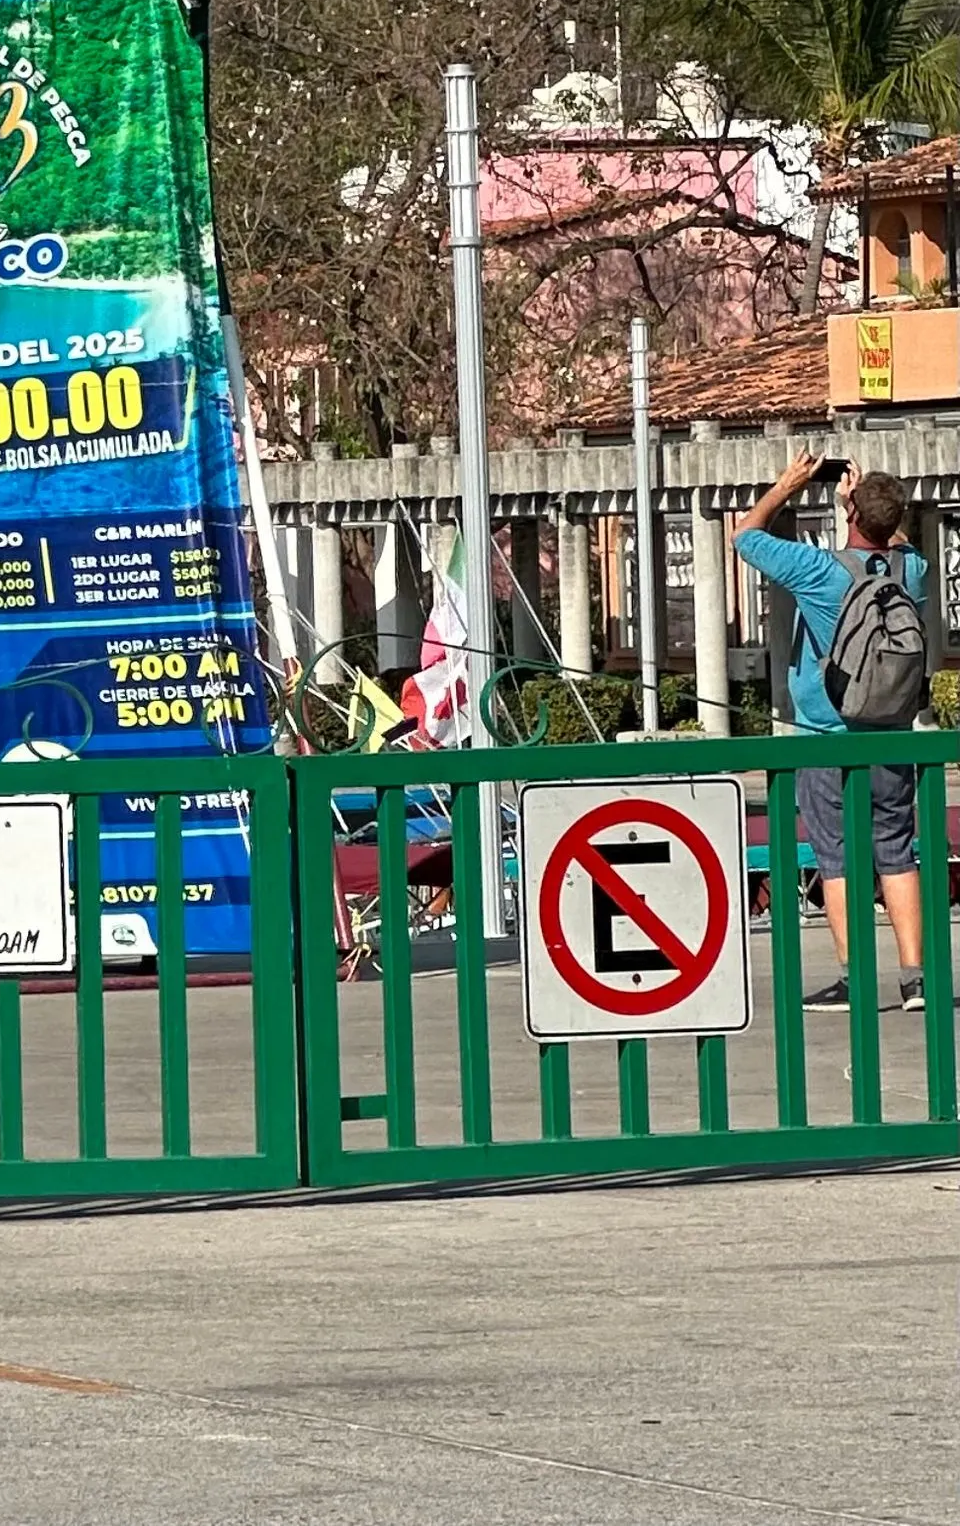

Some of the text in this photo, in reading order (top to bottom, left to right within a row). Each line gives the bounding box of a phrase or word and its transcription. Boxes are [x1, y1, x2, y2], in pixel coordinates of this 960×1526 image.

[11, 57, 46, 92] DE
[40, 86, 92, 168] PESCA
[66, 327, 145, 359] 2025
[5, 443, 62, 472] BOLSA
[63, 430, 174, 467] ACUMULADA
[94, 518, 203, 542] C&R MARLÍN
[70, 555, 98, 569] 1ER
[100, 553, 152, 567] LUGAR
[73, 573, 106, 587] 2DO
[108, 569, 161, 585] LUGAR
[75, 590, 105, 604] 3ER
[107, 586, 160, 601] LUGAR
[106, 639, 156, 655] HORA
[159, 638, 184, 652] DE
[108, 653, 188, 683] 7:00
[99, 687, 160, 703] CIERRE
[163, 684, 187, 699] DE
[117, 699, 193, 728] 5:00
